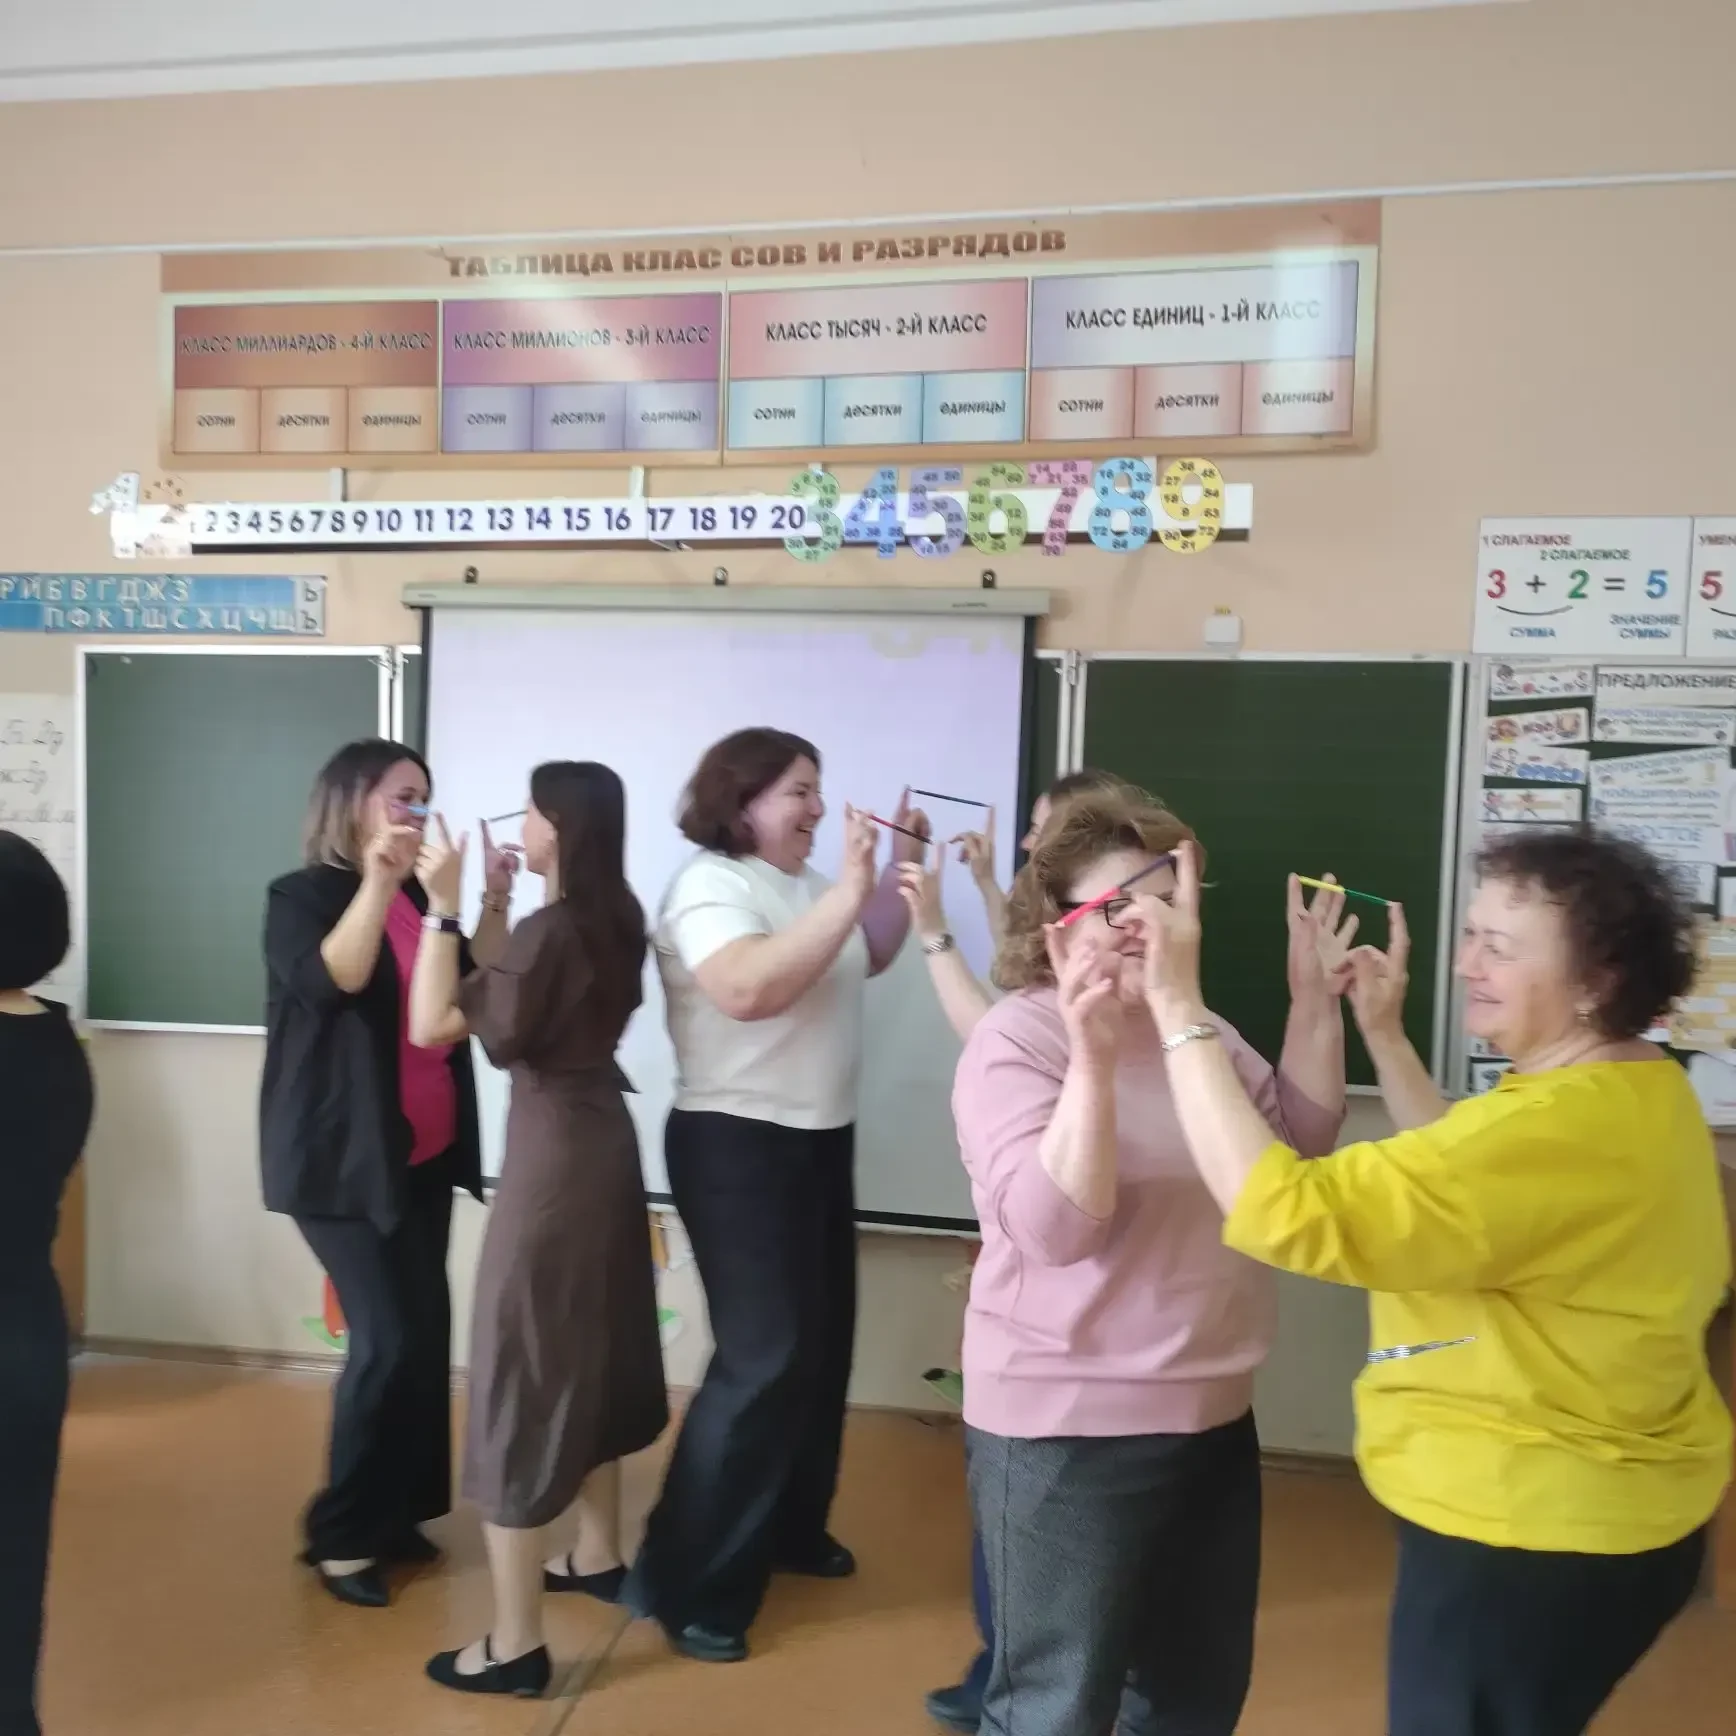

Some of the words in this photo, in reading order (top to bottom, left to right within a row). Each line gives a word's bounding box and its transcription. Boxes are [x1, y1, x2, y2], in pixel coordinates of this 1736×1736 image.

[450, 252, 613, 277] ТАБЛИЦА
[623, 247, 721, 271] КЛАС
[731, 244, 807, 267] СОВ
[818, 241, 841, 263] И
[852, 230, 1066, 262] РАЗРЯДОВ
[766, 321, 822, 341] КЛАСС
[828, 318, 881, 340] ТЫСЯЧ
[896, 313, 922, 336] 2-Й
[928, 314, 987, 334] КЛАСС
[1066, 308, 1126, 330] КЛАСС
[1133, 305, 1204, 330] ЕДИНИЦ
[1221, 298, 1249, 323] 1-Й
[1256, 301, 1320, 321] КЛАСС
[183, 335, 232, 354] КЛАСС
[236, 333, 337, 355] МИЛЛИАРДОВ
[379, 332, 432, 350] КЛАСС
[454, 331, 507, 350] КЛАСС
[512, 328, 611, 350] МИЛЛИОНОВ
[655, 326, 711, 345] КЛАСС
[940, 400, 1006, 416] единицы
[1155, 394, 1220, 410] десятки
[1262, 390, 1334, 405] единицы
[277, 415, 331, 427] десятки
[550, 412, 606, 425] десятки
[843, 404, 902, 419] десятки
[784, 467, 842, 562] 3
[845, 467, 905, 559] 4
[908, 463, 968, 560] 5
[968, 463, 1025, 555] 6
[1028, 460, 1092, 557] 7
[1088, 456, 1154, 553] 8
[1159, 457, 1226, 554] 9
[205, 510, 218, 532] 2
[226, 510, 240, 534] 3
[248, 510, 262, 533] 4
[269, 510, 283, 533] 5
[290, 510, 305, 533] 6
[310, 510, 324, 532] 7
[330, 510, 345, 533] 8
[353, 509, 368, 532] 9
[376, 509, 401, 532] 10
[414, 509, 434, 532] 11
[446, 508, 473, 532] 12
[488, 508, 514, 531] 13
[526, 507, 552, 530] 14
[563, 507, 591, 531] 15
[604, 506, 631, 531] 16
[647, 507, 674, 531] 17
[690, 507, 717, 531] 18
[730, 505, 756, 530] 19
[771, 505, 806, 529] 20
[1492, 534, 1572, 546] СЛАГАЕМОЕ
[1549, 549, 1631, 561] СЛАГАЕМОЕ
[1487, 569, 1506, 599] 3
[1526, 575, 1546, 593] +
[1567, 569, 1590, 599] 2
[1603, 577, 1625, 591] =
[1645, 569, 1668, 599] 5
[1699, 570, 1723, 600] 5
[1510, 627, 1556, 638] СУММА
[1609, 614, 1681, 625] ЗНАЧЕНИЕ
[1619, 628, 1671, 639] СУММЫ
